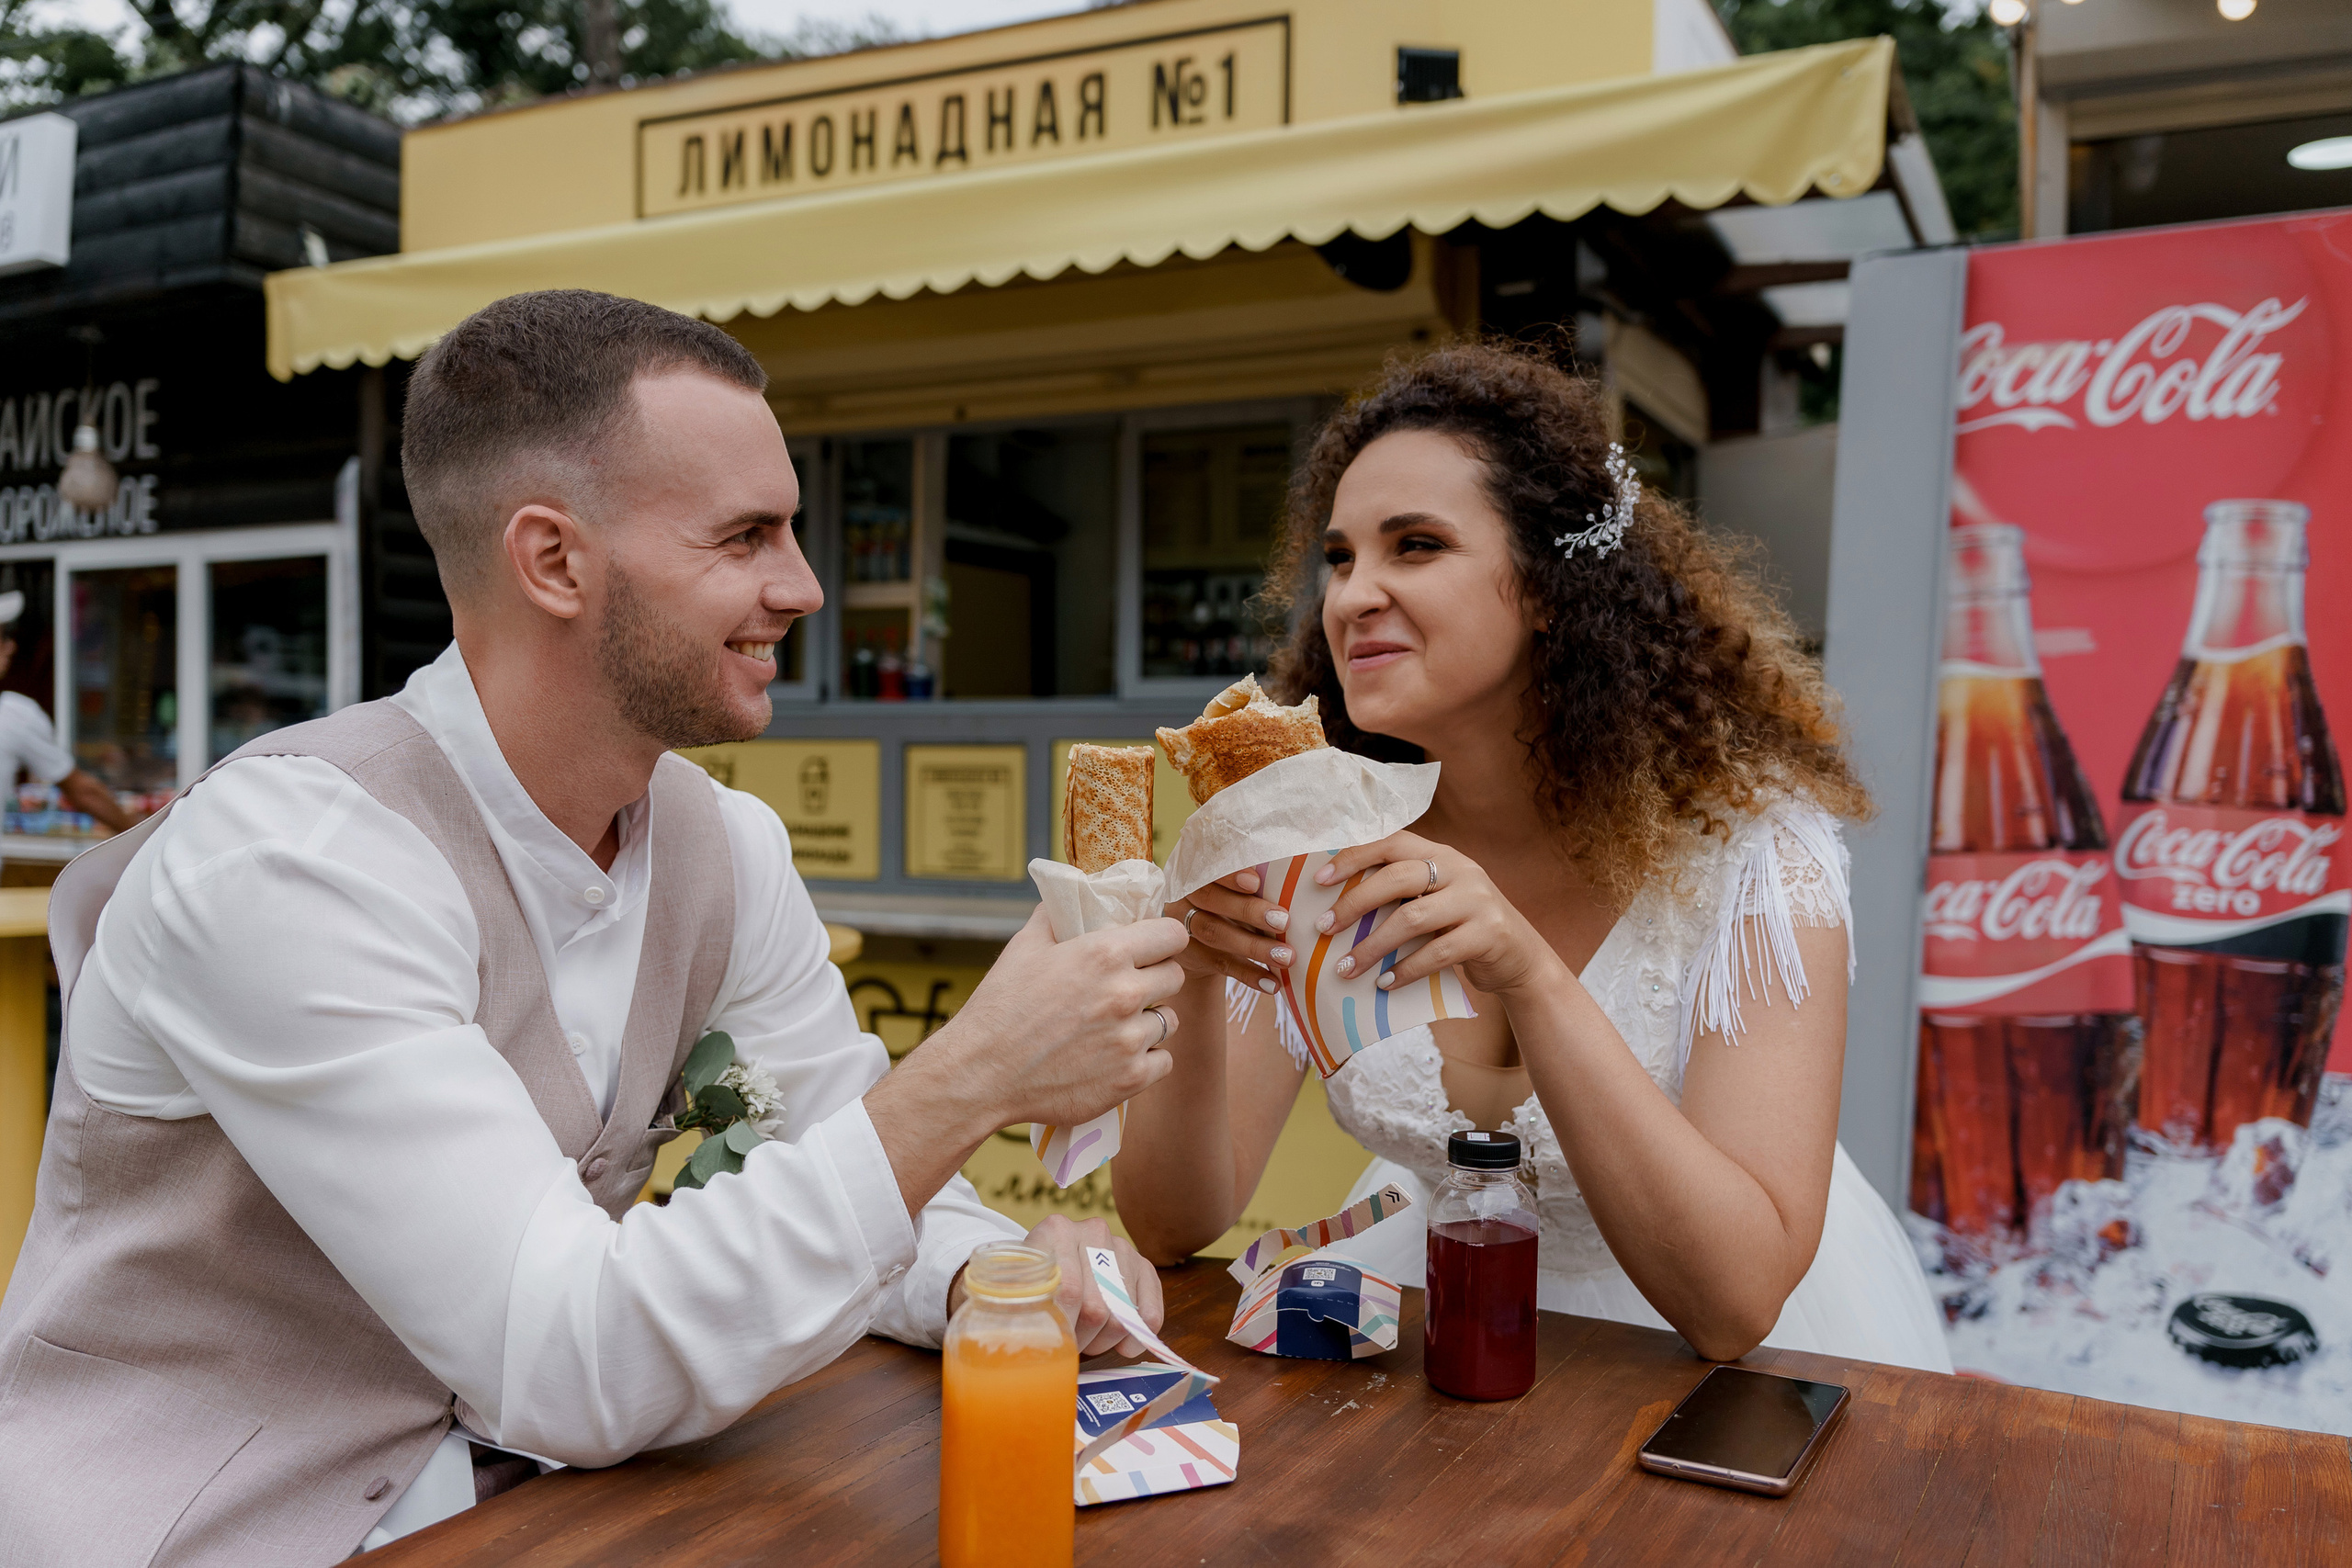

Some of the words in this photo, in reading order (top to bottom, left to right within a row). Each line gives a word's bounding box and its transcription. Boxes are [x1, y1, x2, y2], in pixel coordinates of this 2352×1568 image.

[675, 72, 1107, 198] ЛИМОНАДНАЯ
[1150, 51, 1237, 130] №1
[2115, 809, 2342, 895] Coca-Cola
[1923, 859, 2109, 942] ca-Cola
[2172, 884, 2261, 916] zero
